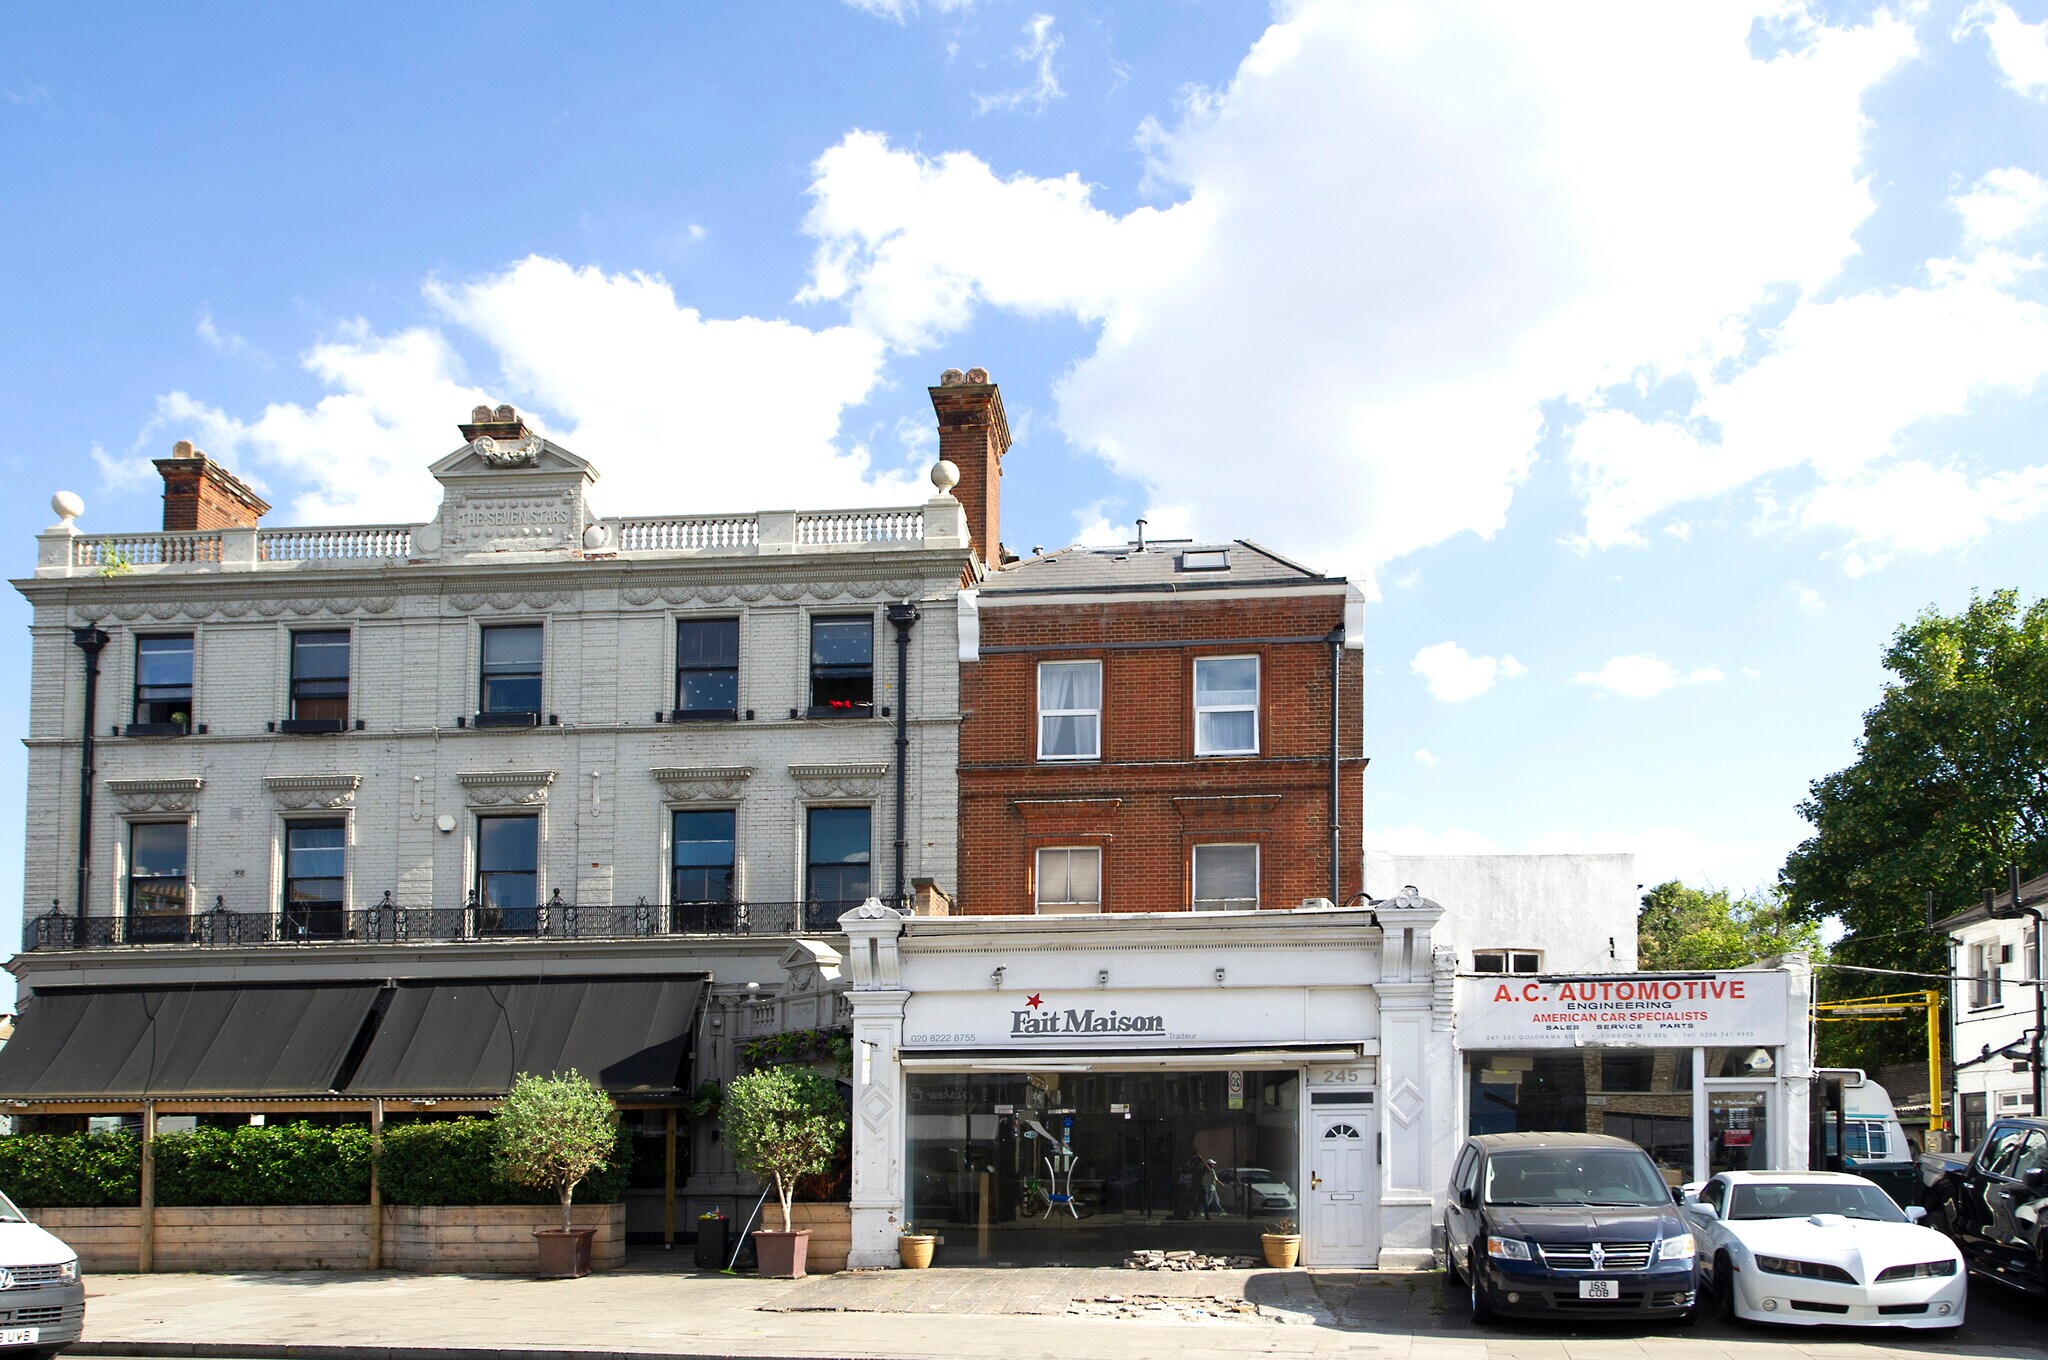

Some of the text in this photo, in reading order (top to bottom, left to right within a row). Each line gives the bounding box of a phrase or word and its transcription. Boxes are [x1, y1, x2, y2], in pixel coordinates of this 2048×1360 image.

[459, 509, 569, 527] THE SEVEN STARS
[1494, 981, 1745, 1002] A.C. AUTOMOTIVE
[1567, 1001, 1672, 1010] ENGINEERING
[1011, 1009, 1165, 1034] Fait Maison
[1532, 1011, 1708, 1023] AMERICAN CAR SPECIALISTS
[911, 1033, 976, 1042] 020 8222 8755
[1168, 1032, 1197, 1040] Traiteur
[1324, 1070, 1358, 1083] 245
[1591, 1281, 1607, 1289] 159
